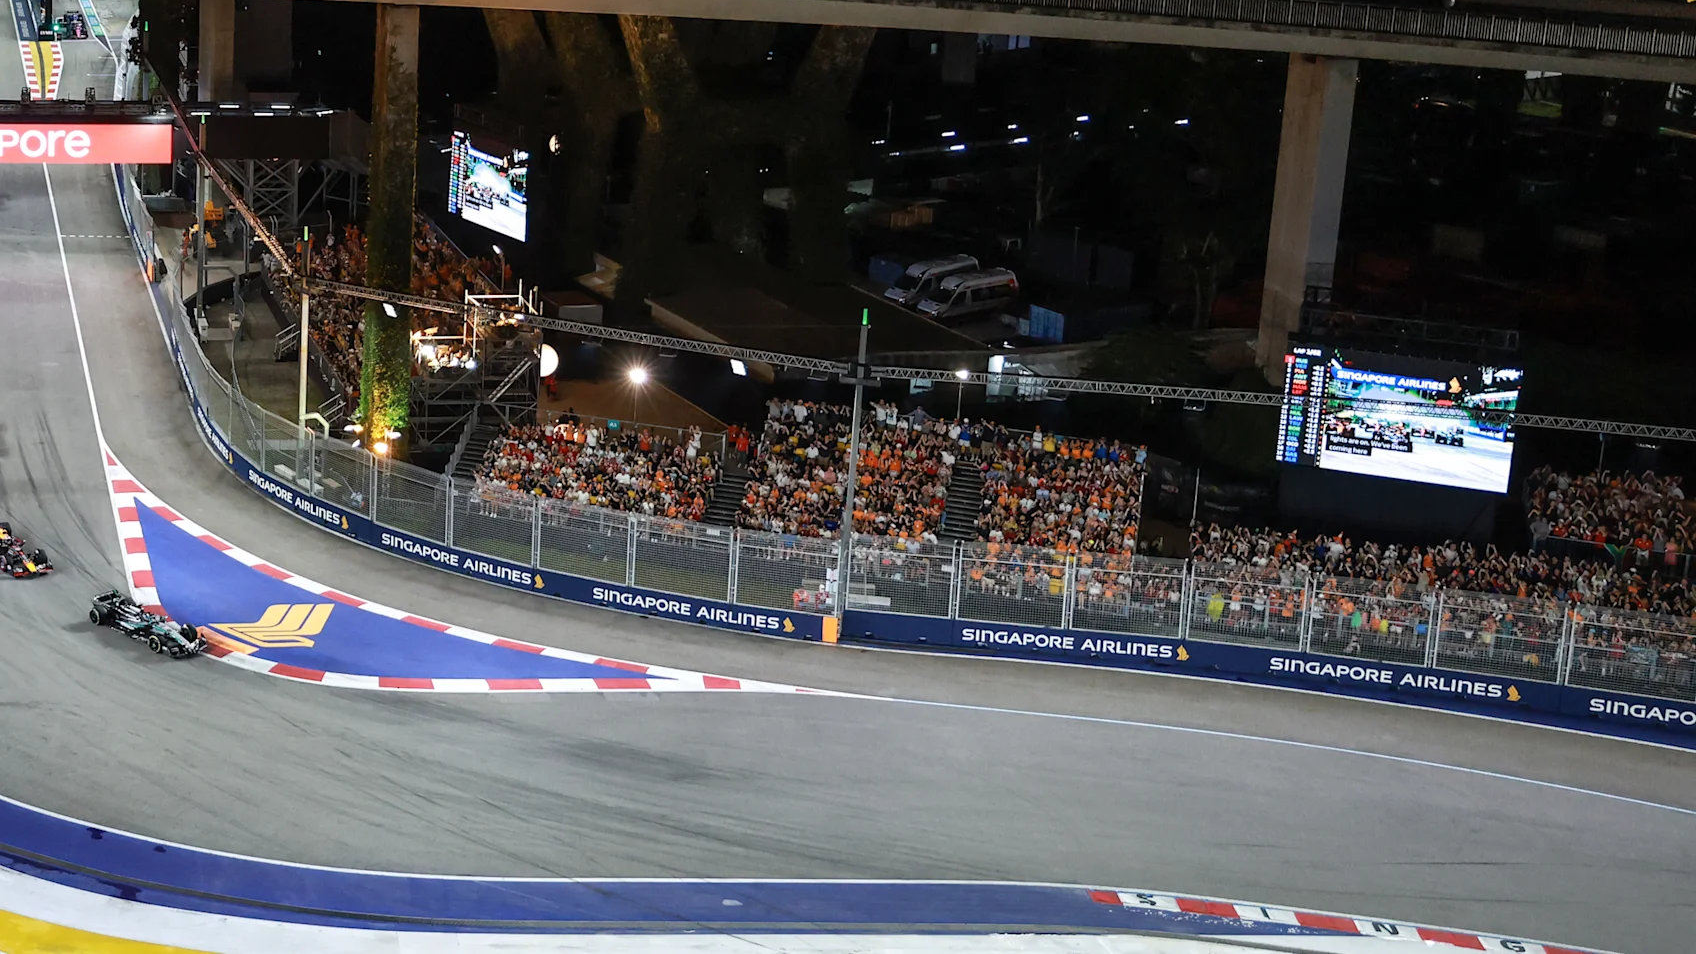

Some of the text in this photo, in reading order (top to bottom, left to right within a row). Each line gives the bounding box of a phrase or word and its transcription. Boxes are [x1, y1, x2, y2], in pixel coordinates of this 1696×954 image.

[1328, 445, 1368, 455] coming here
[1329, 435, 1348, 444] lights
[1391, 442, 1408, 451] been
[248, 469, 340, 525] SINGAPORE AIRLINES
[381, 532, 532, 585] SINGAPORE AIRLINES
[592, 587, 780, 630] SINGAPORE AIRLINES
[961, 627, 1173, 658] SINGAPORE AIRLINES
[1269, 657, 1503, 697] SINGAPORE AIRLINES
